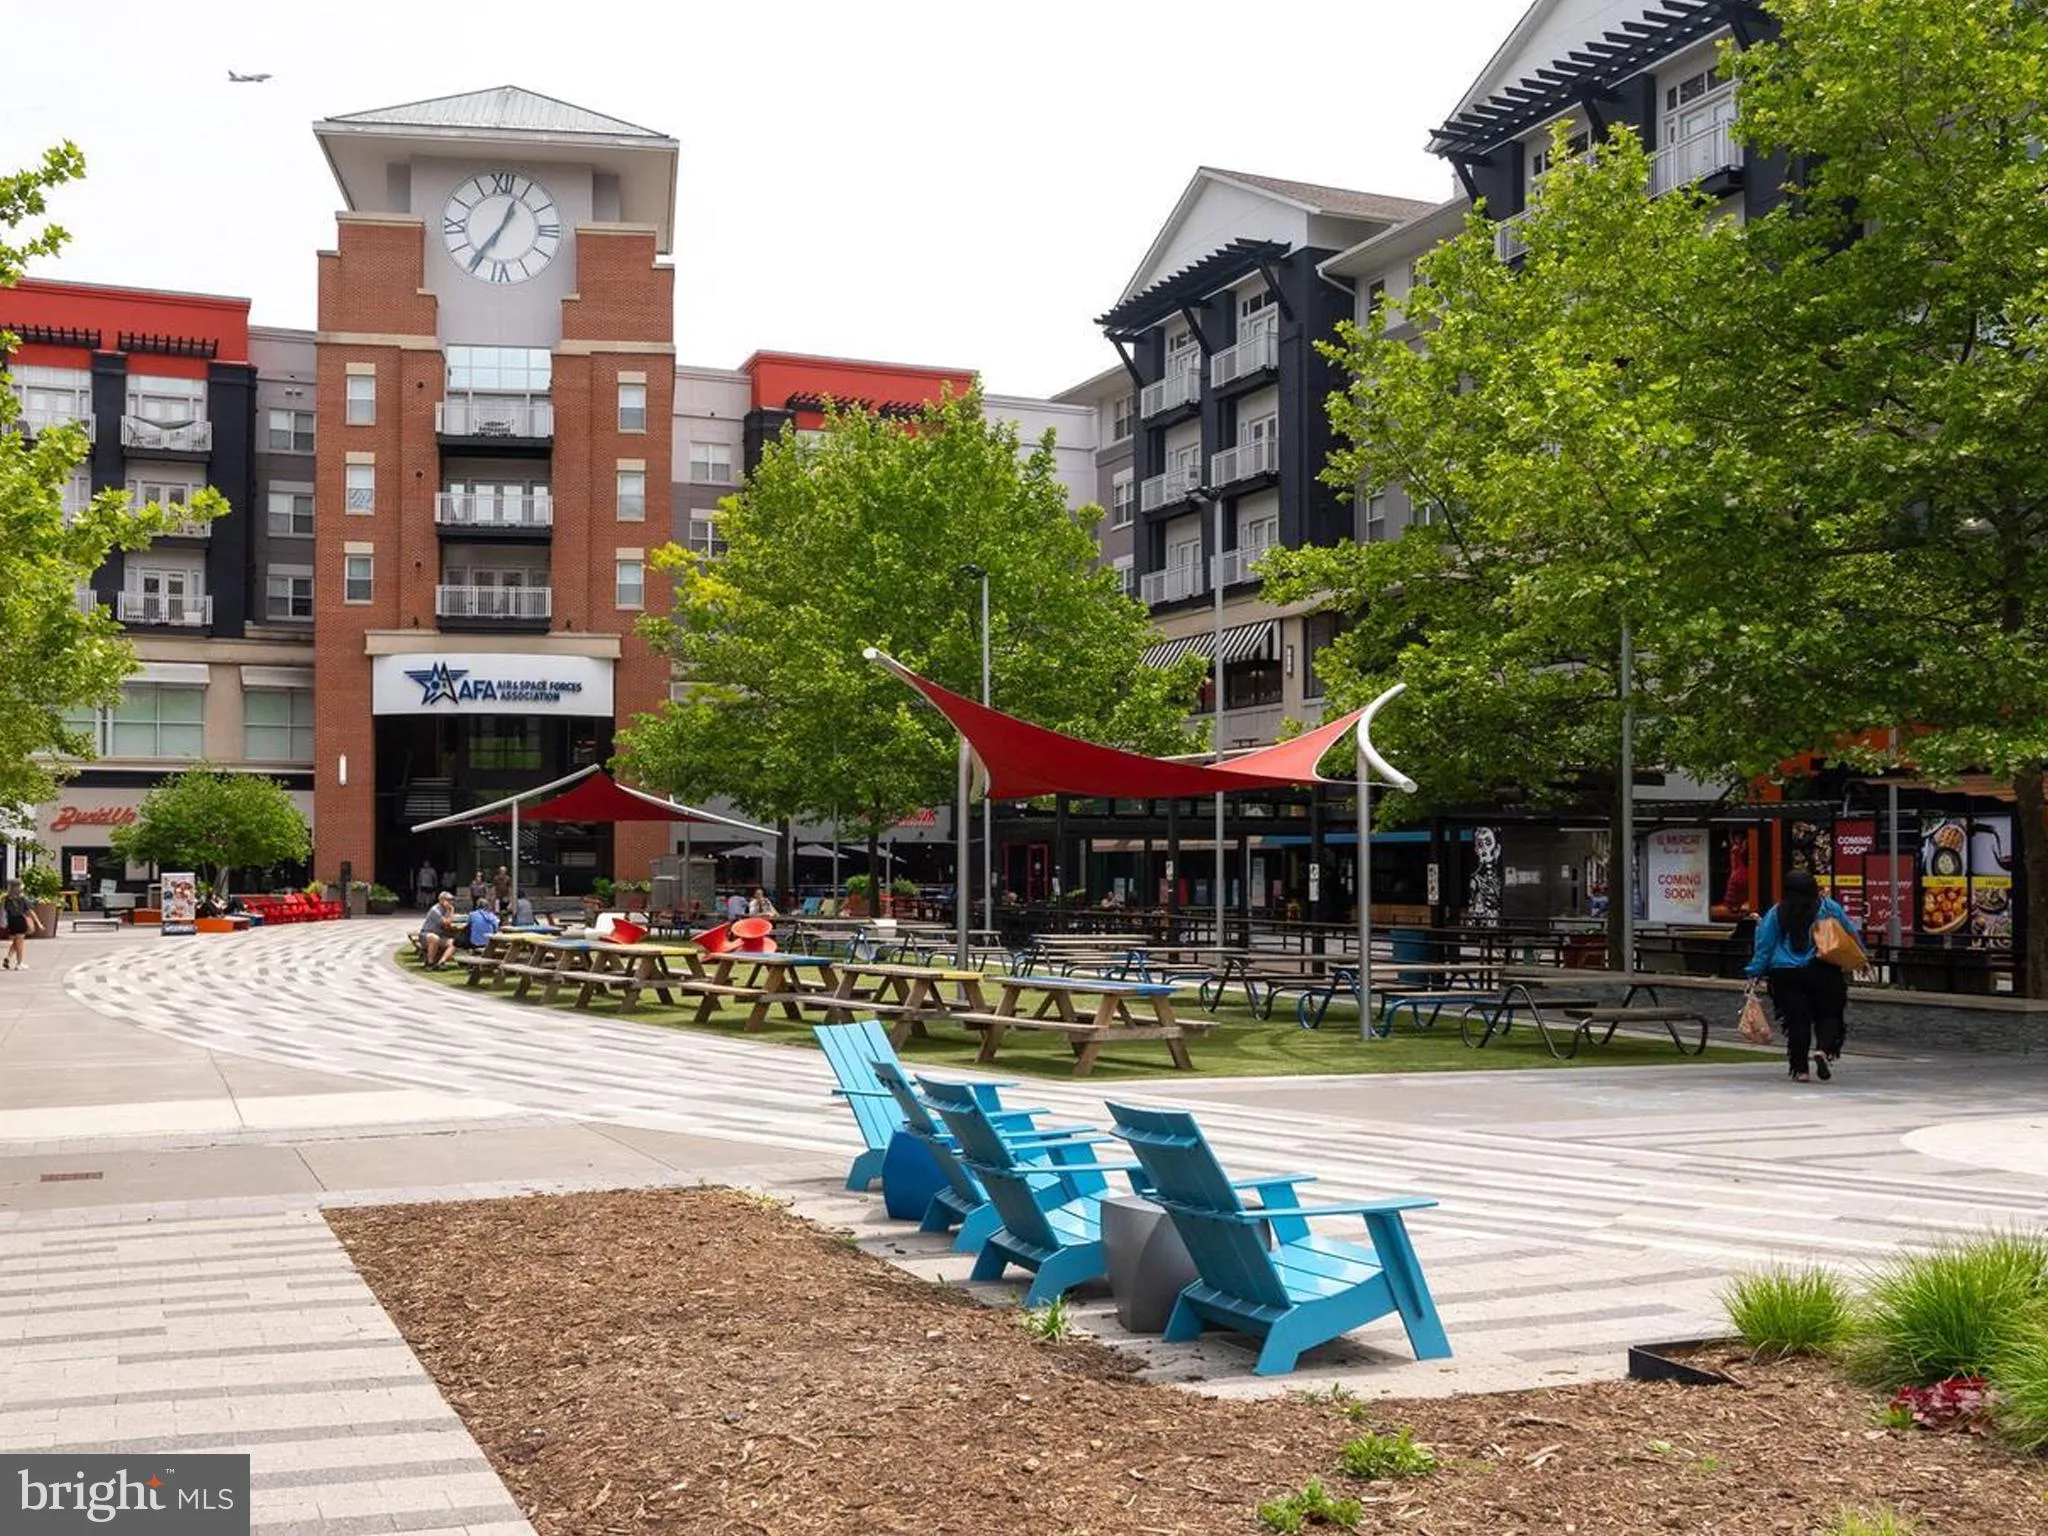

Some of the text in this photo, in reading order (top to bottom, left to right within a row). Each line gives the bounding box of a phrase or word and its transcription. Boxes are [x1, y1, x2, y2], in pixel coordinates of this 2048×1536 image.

[458, 680, 498, 701] AFA
[549, 681, 582, 693] FORCES
[500, 690, 560, 702] ASSOCIATION
[1837, 836, 1873, 846] COMING
[1842, 846, 1868, 855] SOON
[1657, 874, 1702, 886] COMING
[1664, 888, 1695, 900] SOON
